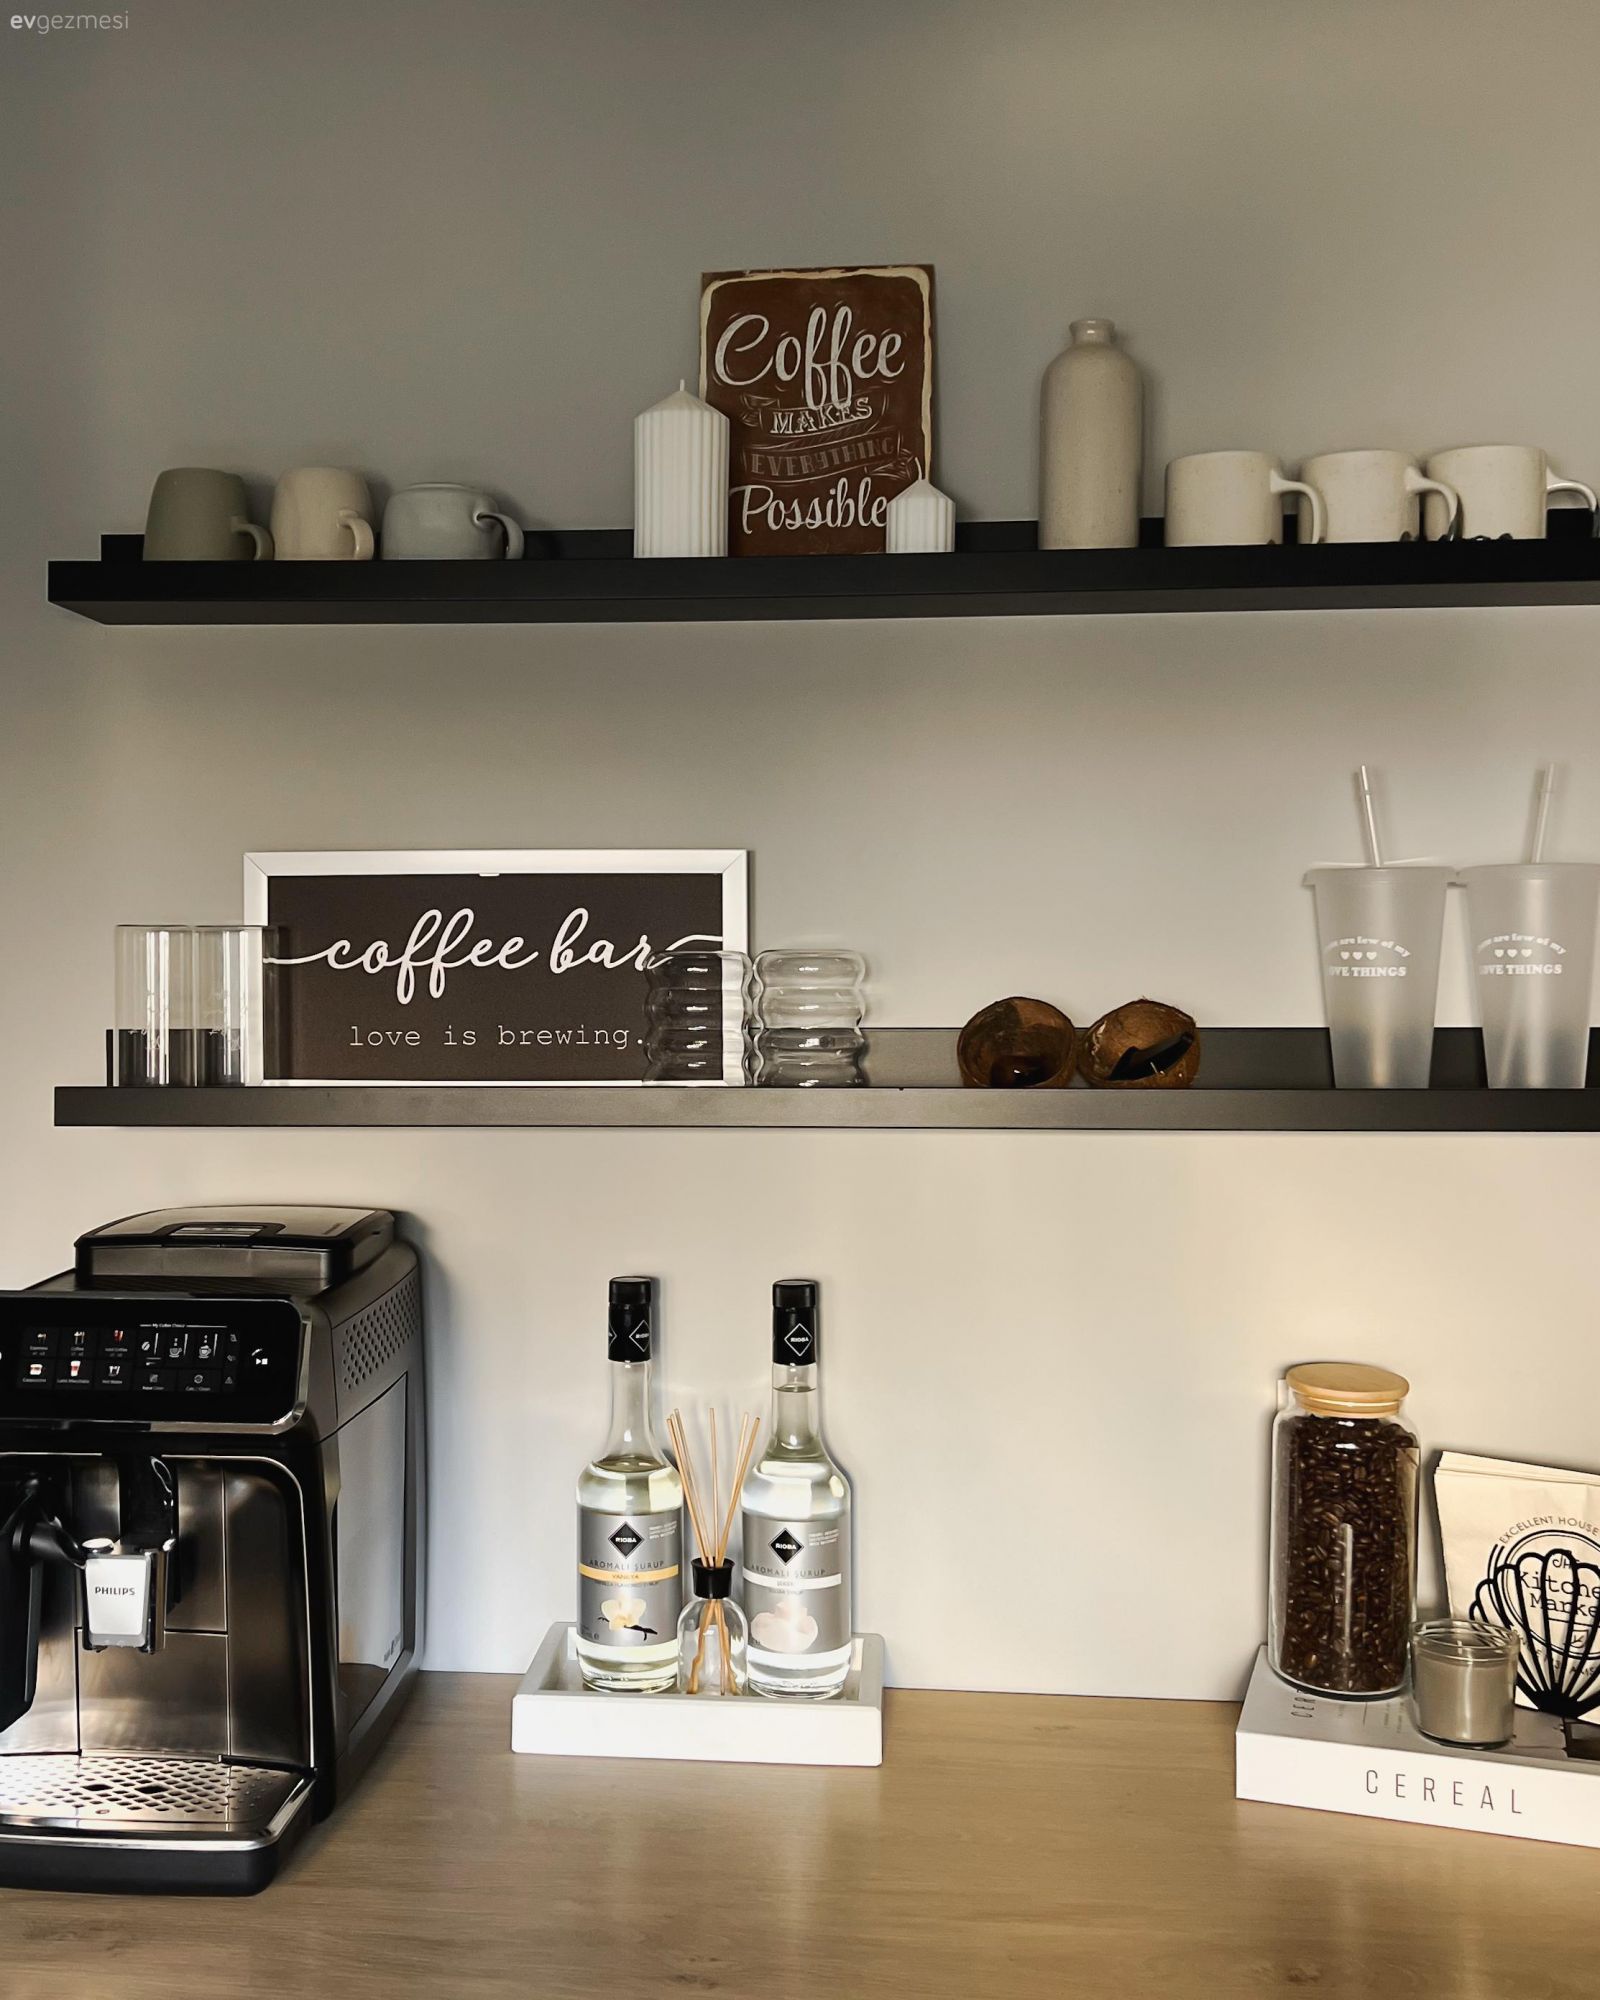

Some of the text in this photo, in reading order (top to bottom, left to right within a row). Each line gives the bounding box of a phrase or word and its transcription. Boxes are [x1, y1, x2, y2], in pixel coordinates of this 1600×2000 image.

[714, 306, 905, 410] Coffee
[769, 397, 873, 434] MAKES
[730, 477, 887, 535] Possible
[322, 907, 658, 1005] coffee bar
[1351, 966, 1407, 977] THINGS
[1505, 964, 1563, 975] THINGS
[350, 1024, 646, 1050] love is brewing.
[1498, 1515, 1600, 1544] EXCELLENT HOUSE
[95, 1586, 136, 1596] PHILIPS
[1366, 1769, 1522, 1815] CEREAL
